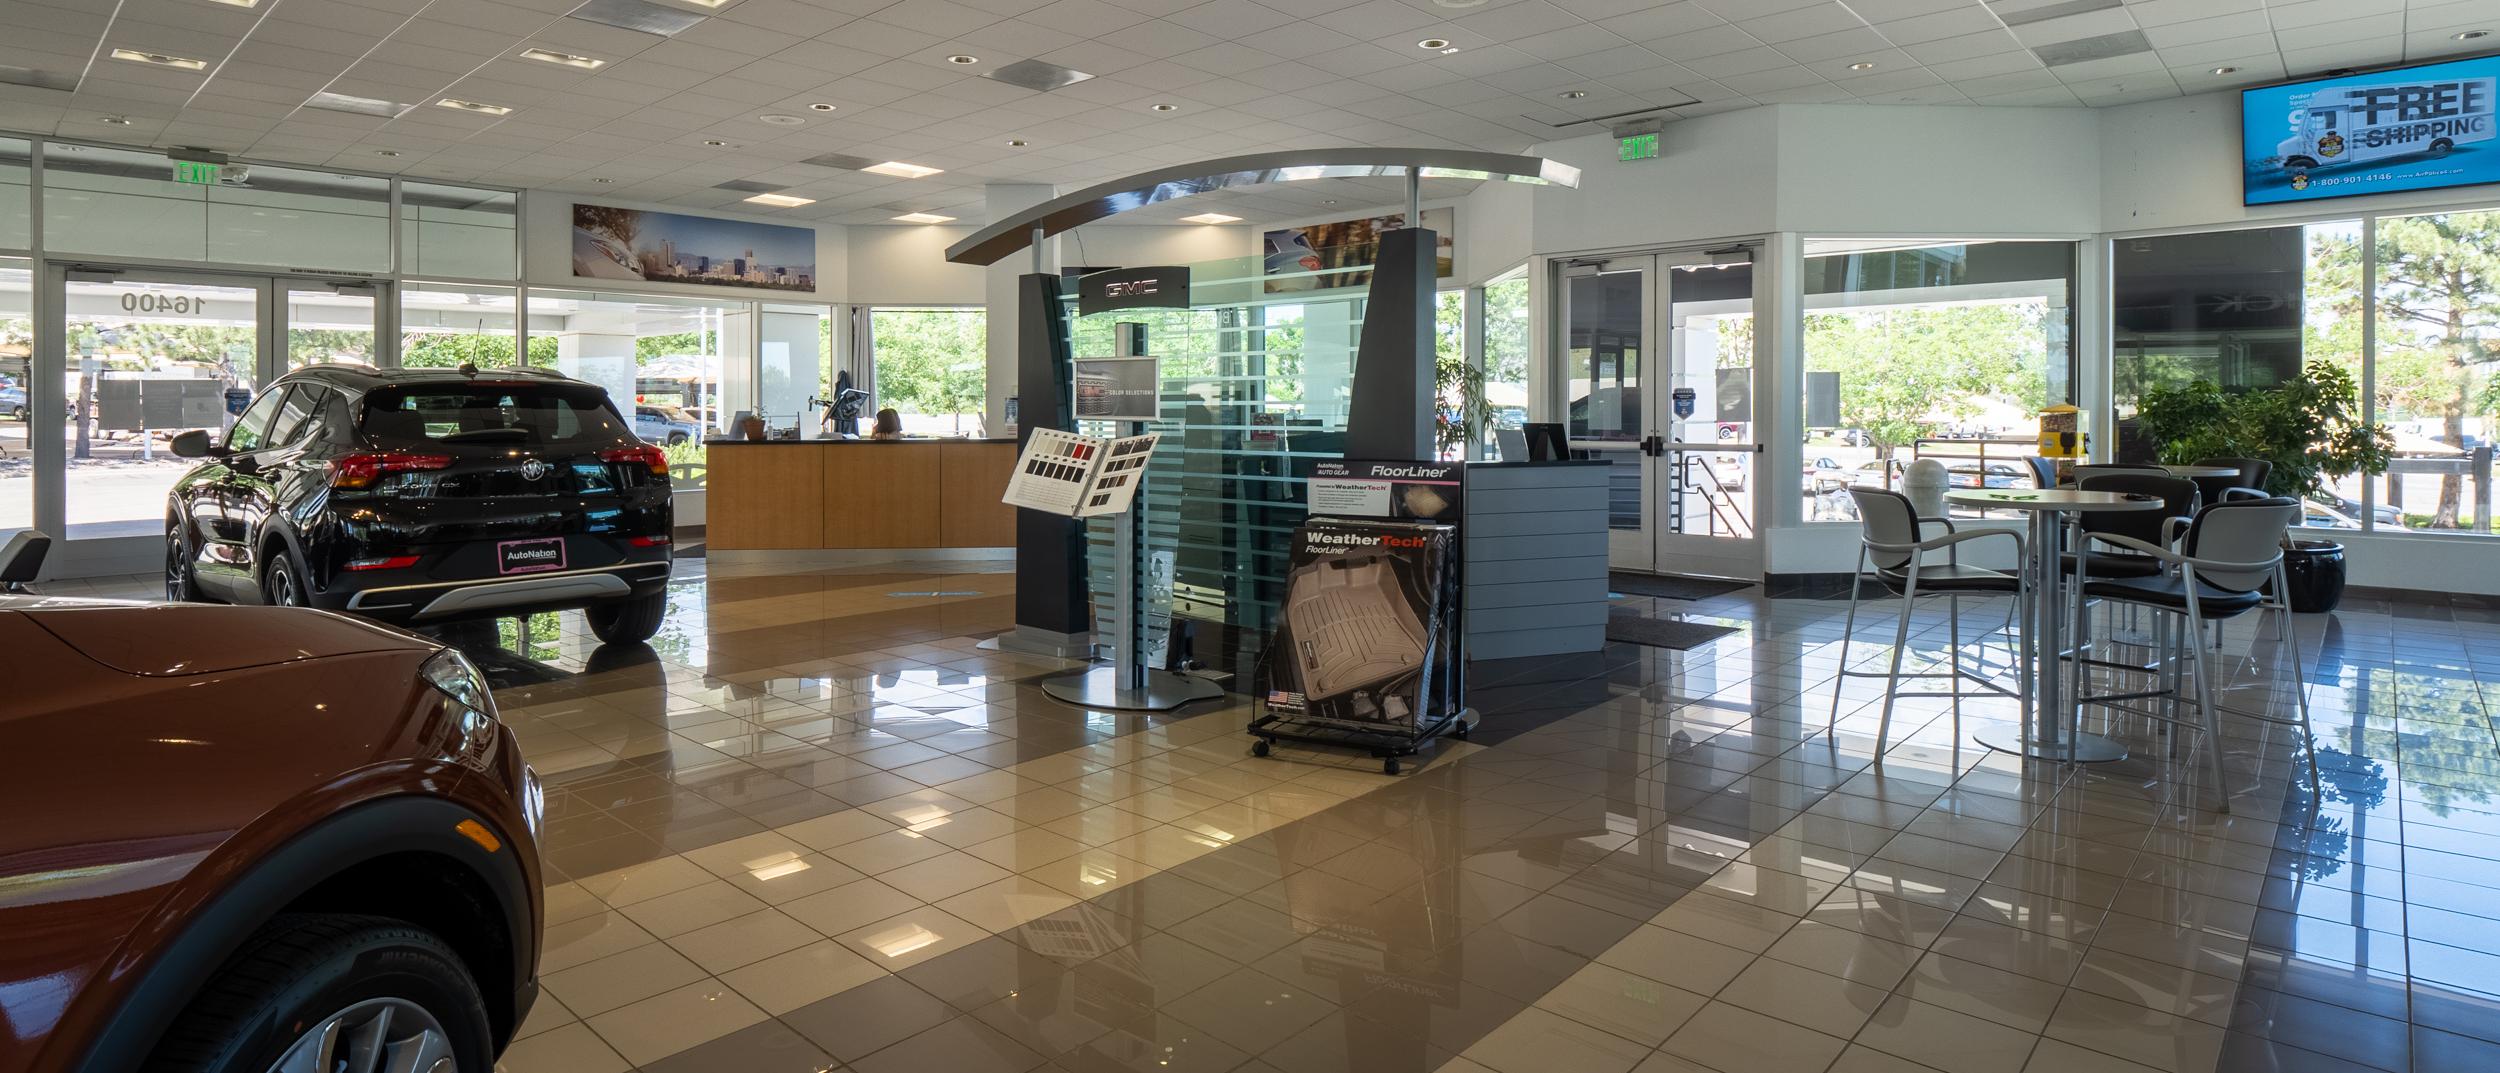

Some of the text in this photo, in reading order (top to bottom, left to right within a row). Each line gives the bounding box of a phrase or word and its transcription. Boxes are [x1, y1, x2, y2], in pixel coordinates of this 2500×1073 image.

[2345, 82, 2486, 125] FREE
[2364, 116, 2485, 148] SHIPPING
[1622, 134, 1656, 160] EXIT
[179, 162, 218, 184] EXIT
[1105, 279, 1158, 298] GMC
[507, 548, 557, 560] AutoNation
